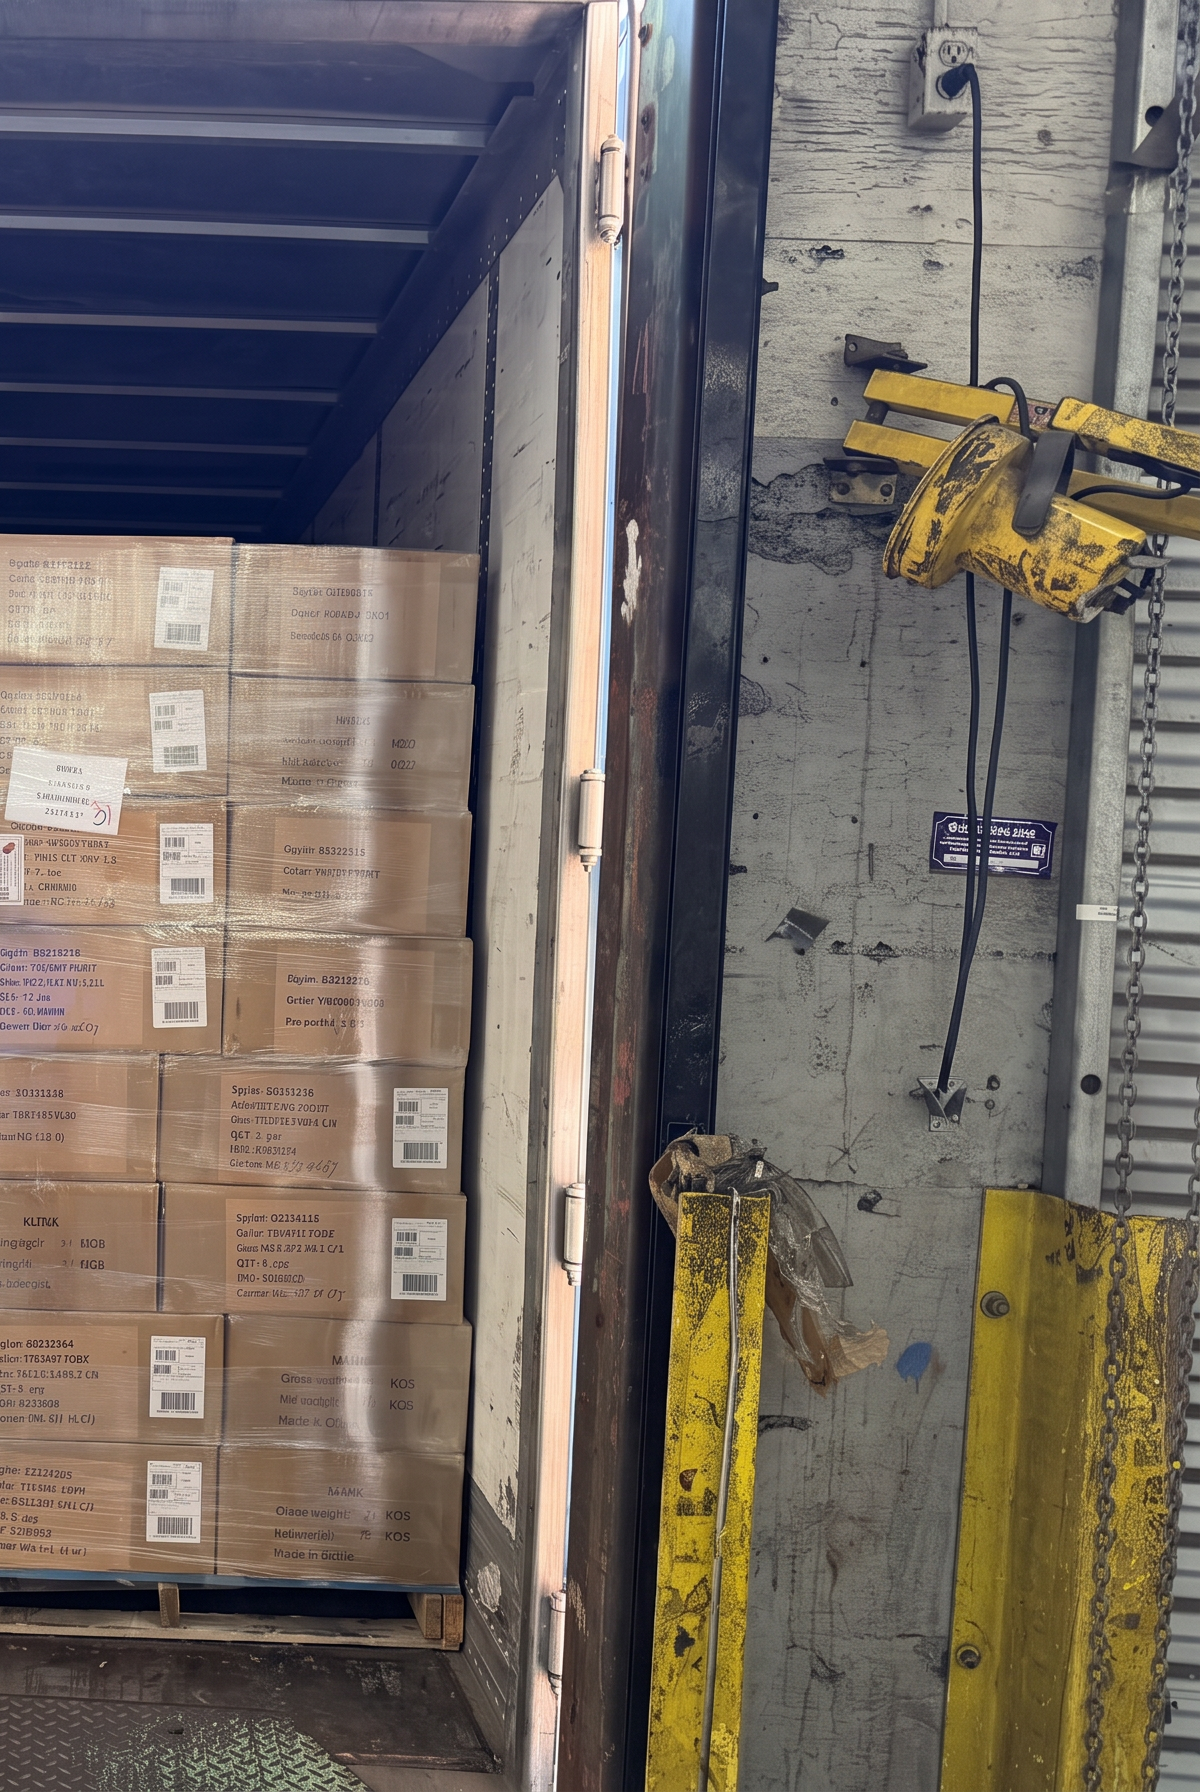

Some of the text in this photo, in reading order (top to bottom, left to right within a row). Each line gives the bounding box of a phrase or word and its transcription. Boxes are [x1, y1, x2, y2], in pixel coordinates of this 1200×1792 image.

[286, 1017, 302, 1026] Pre
[390, 1379, 415, 1389] KOS
[389, 1400, 414, 1411] KOS
[386, 1510, 411, 1520] KOS
[385, 1531, 411, 1542] KOS
[308, 1549, 318, 1560] in
